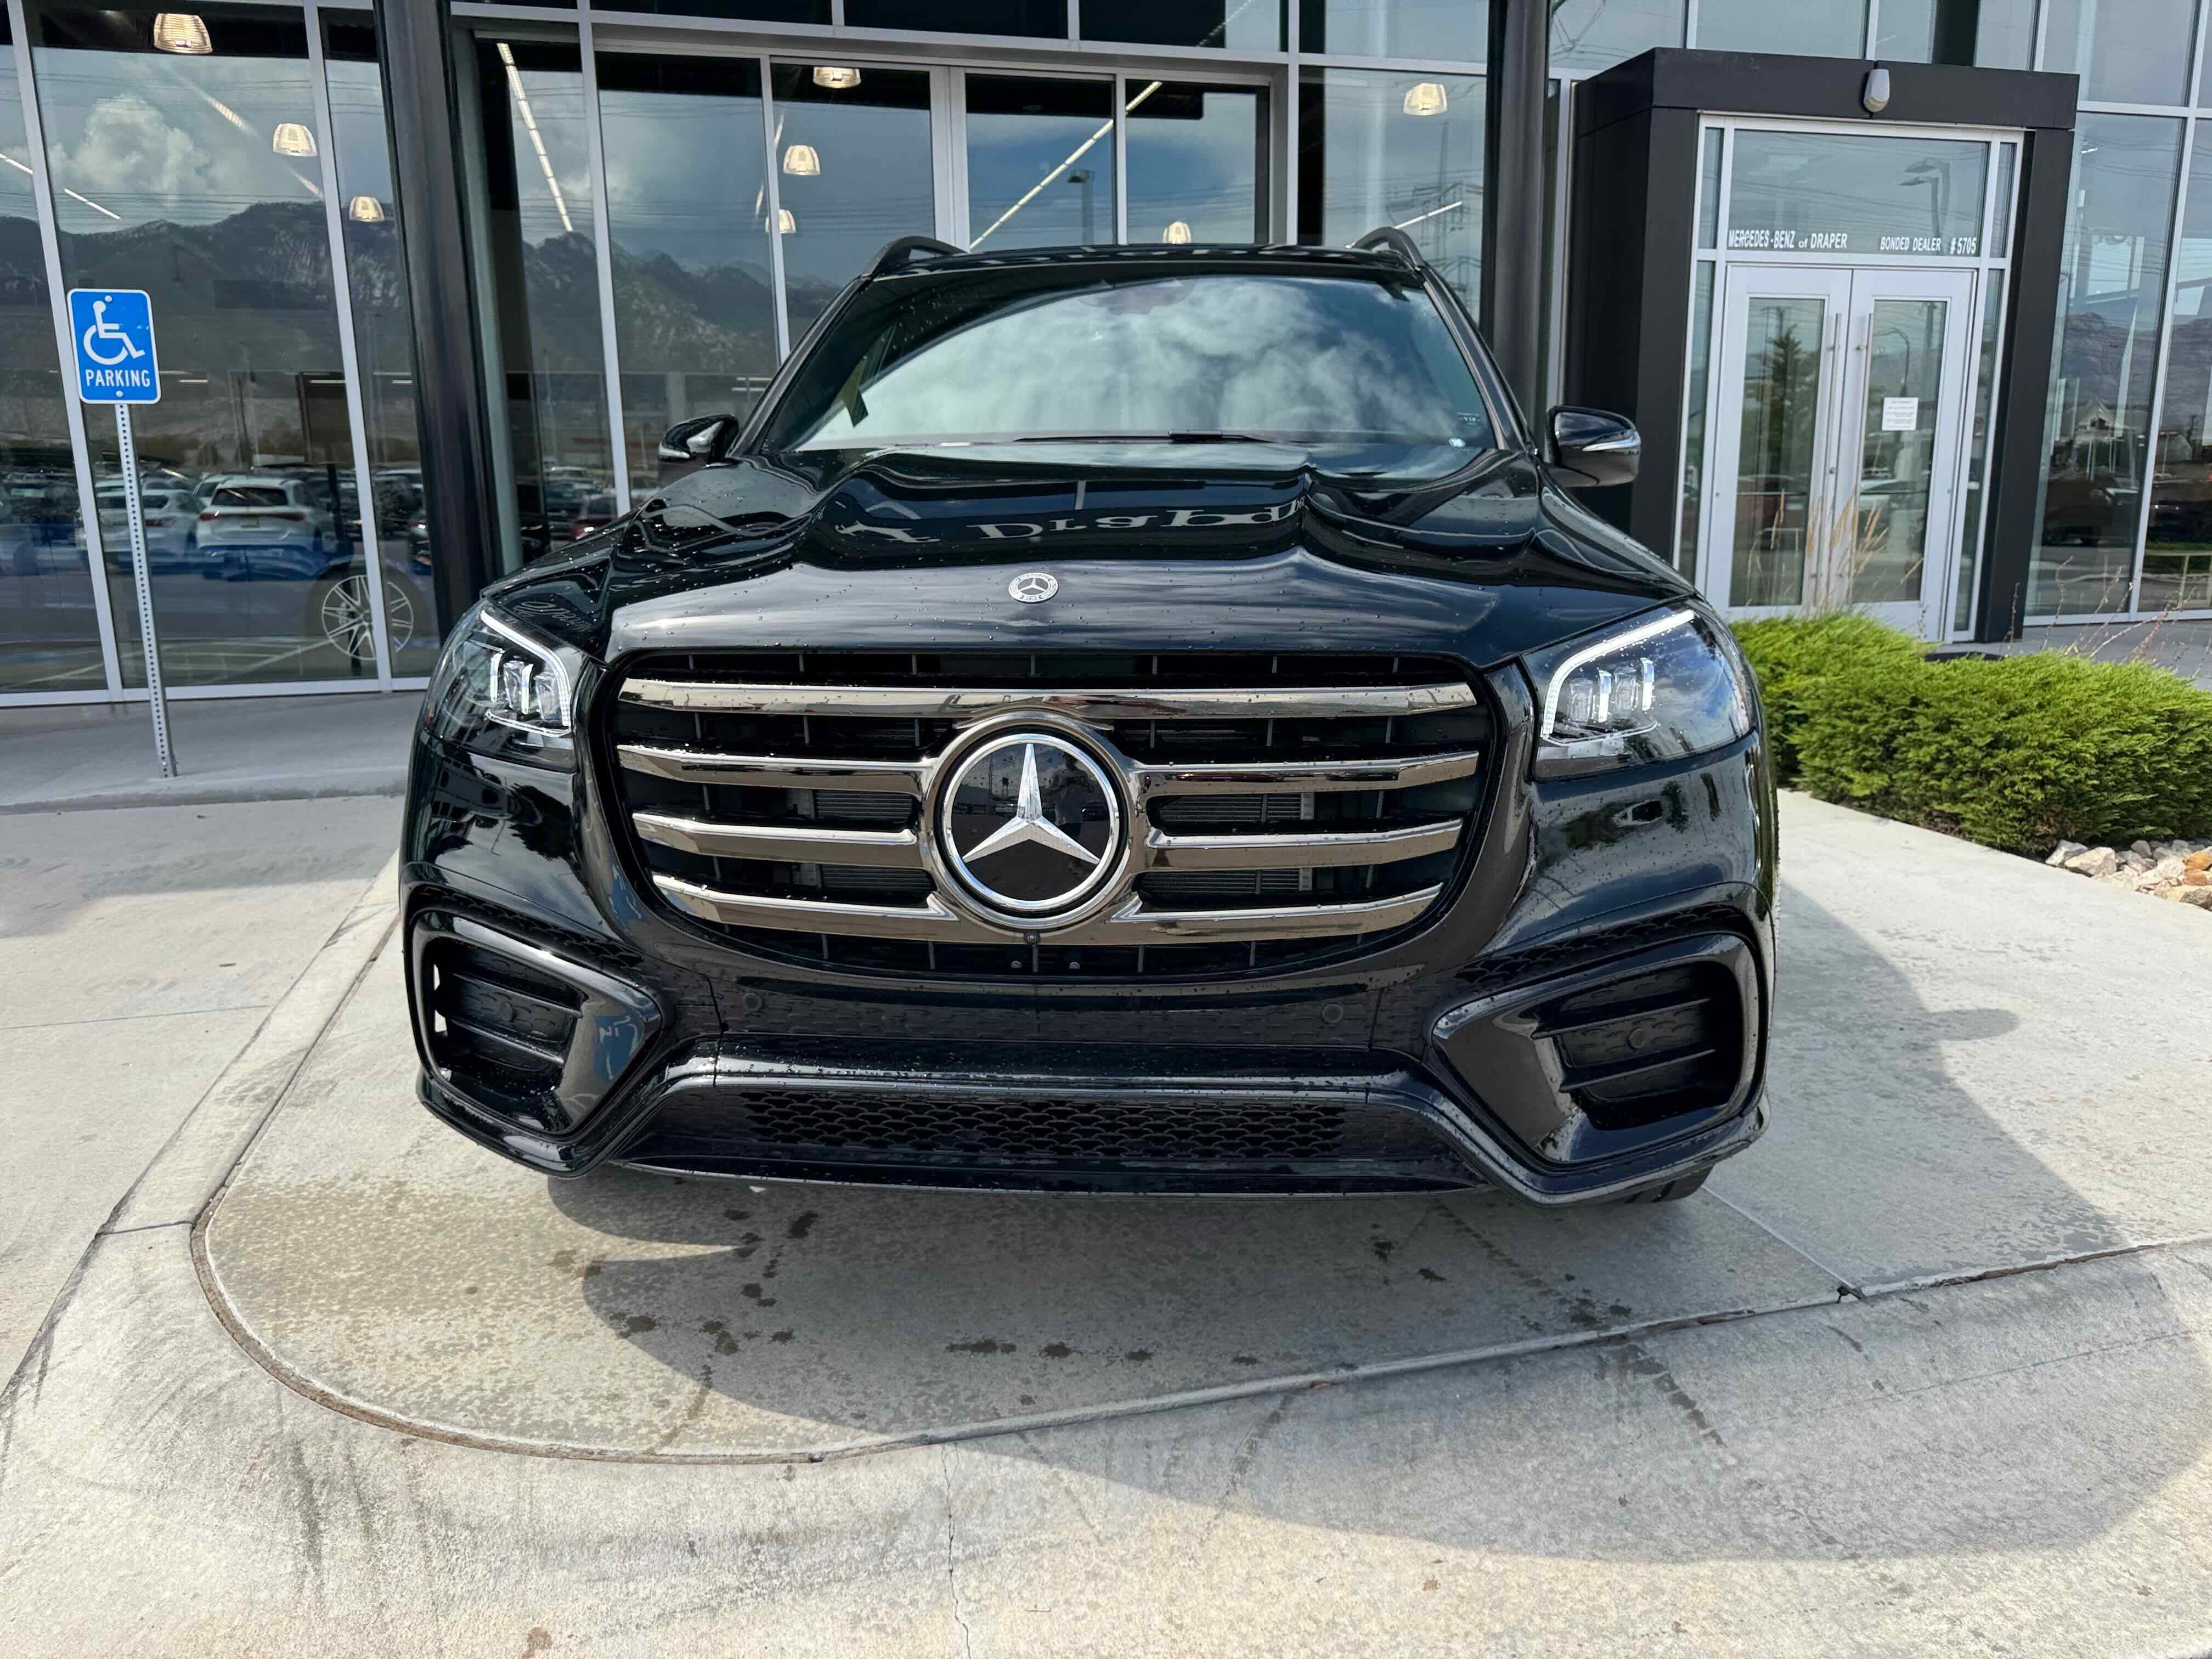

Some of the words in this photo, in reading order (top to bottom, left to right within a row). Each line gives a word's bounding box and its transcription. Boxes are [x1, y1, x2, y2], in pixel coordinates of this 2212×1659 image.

[1798, 238, 1809, 249] of
[1810, 233, 1848, 249] DRAPER
[1880, 236, 1910, 251] BONDED
[1912, 238, 1941, 251] DEALER
[85, 369, 150, 387] PARKING
